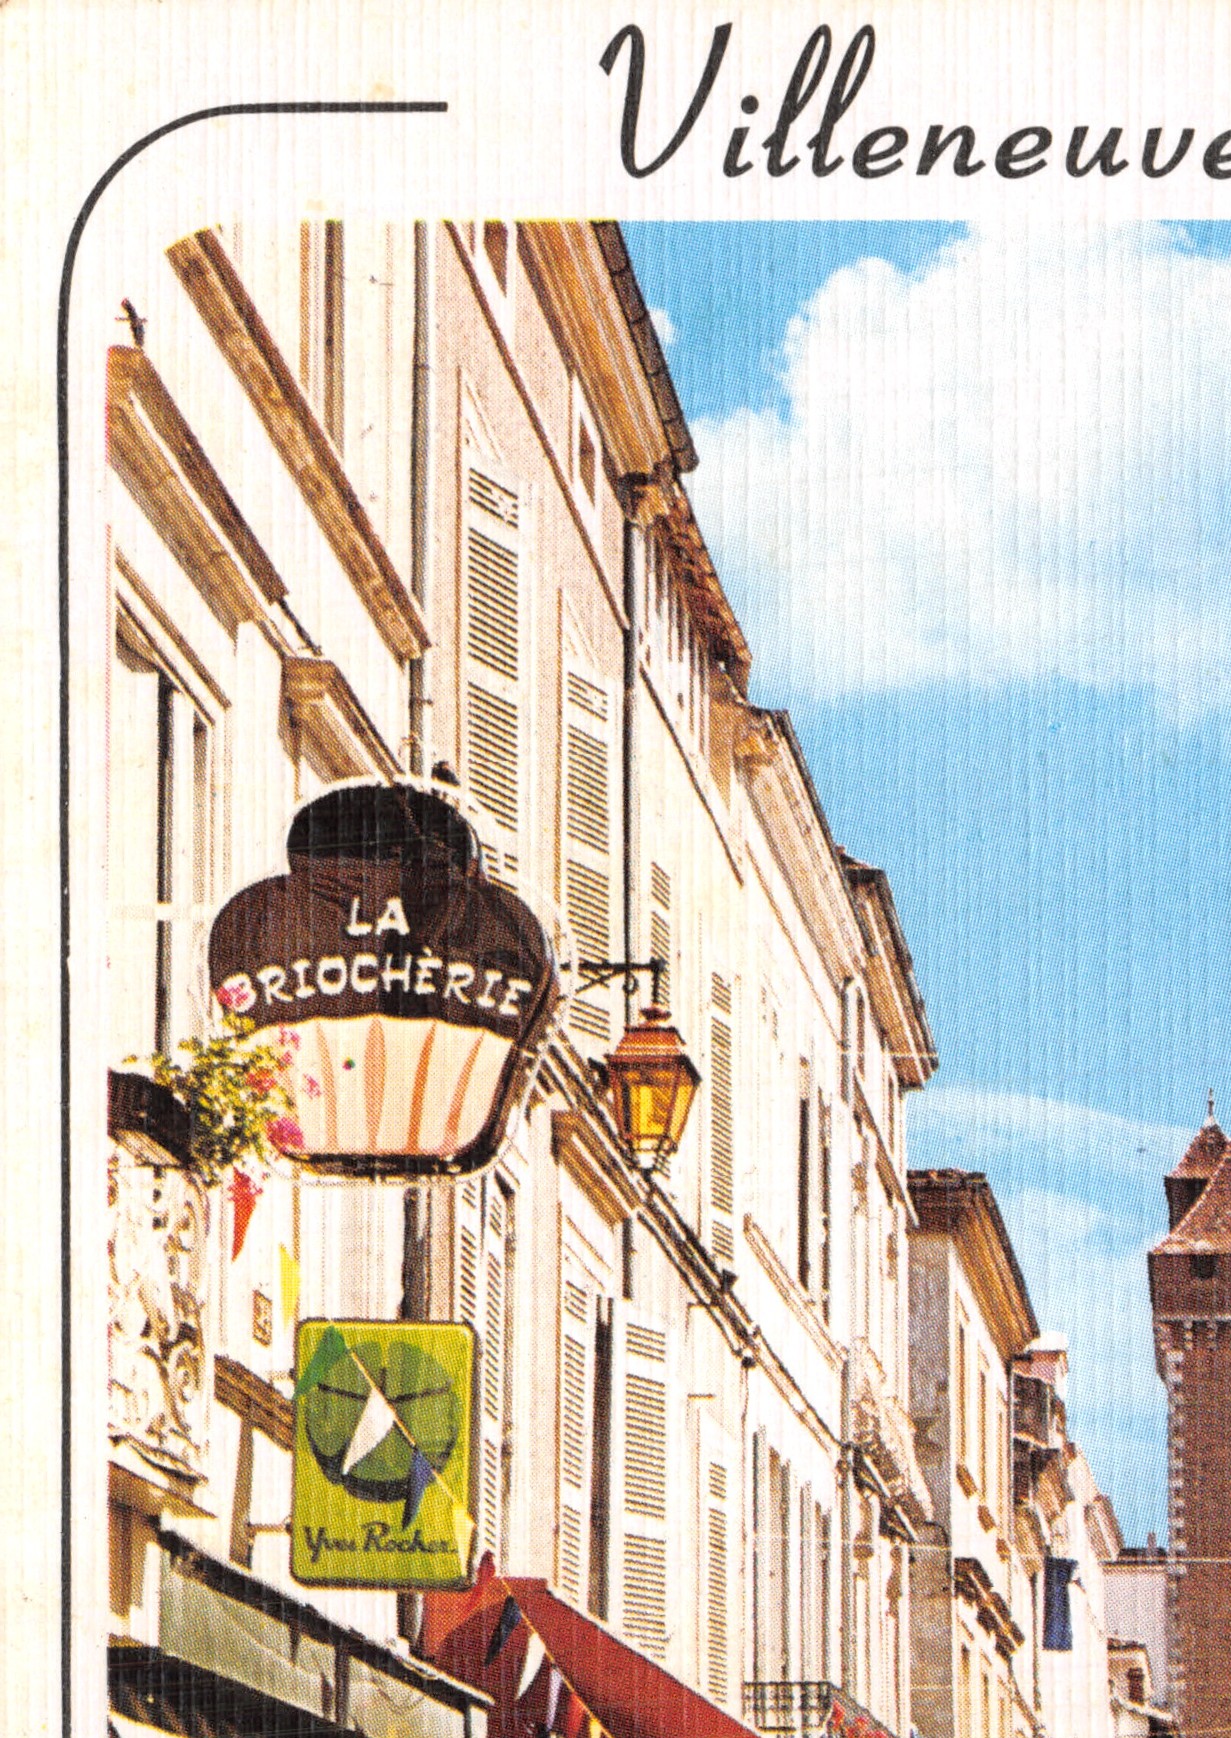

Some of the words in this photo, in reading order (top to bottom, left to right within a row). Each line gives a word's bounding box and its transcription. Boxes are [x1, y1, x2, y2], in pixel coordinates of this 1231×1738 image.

[345, 896, 411, 938] LA
[302, 1525, 356, 1564] Yves
[362, 1520, 449, 1553] Rocher
